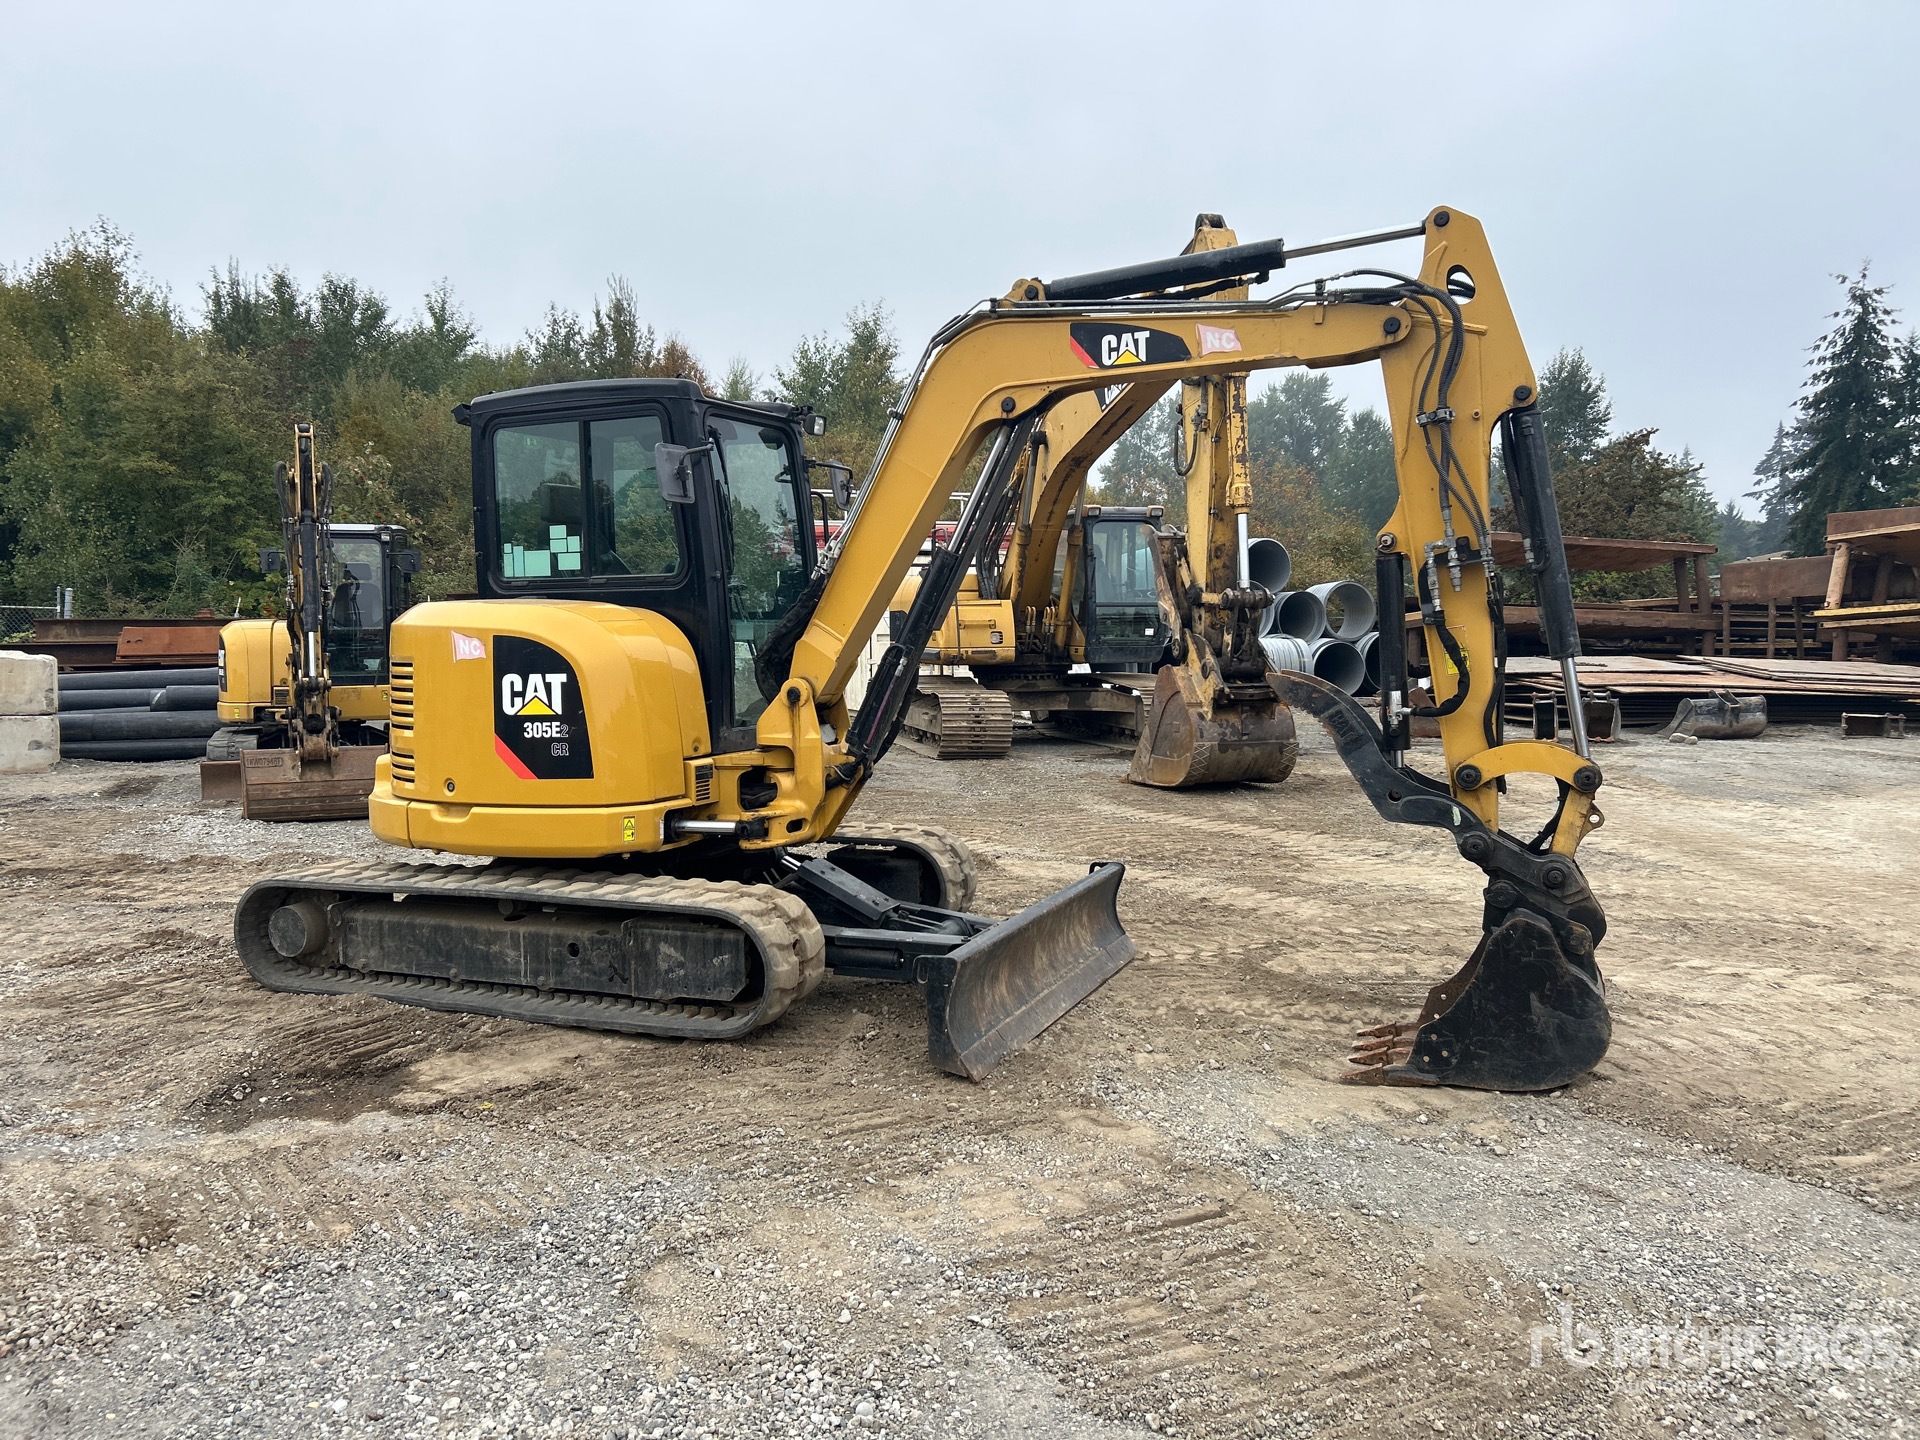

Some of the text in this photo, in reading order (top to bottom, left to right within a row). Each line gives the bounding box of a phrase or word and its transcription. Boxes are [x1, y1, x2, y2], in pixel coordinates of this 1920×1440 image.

[1101, 330, 1150, 366] CAT
[1205, 331, 1236, 350] NC
[459, 638, 482, 656] NC
[502, 673, 568, 716] CAT
[523, 721, 569, 738] 305E2
[551, 742, 569, 757] CR
